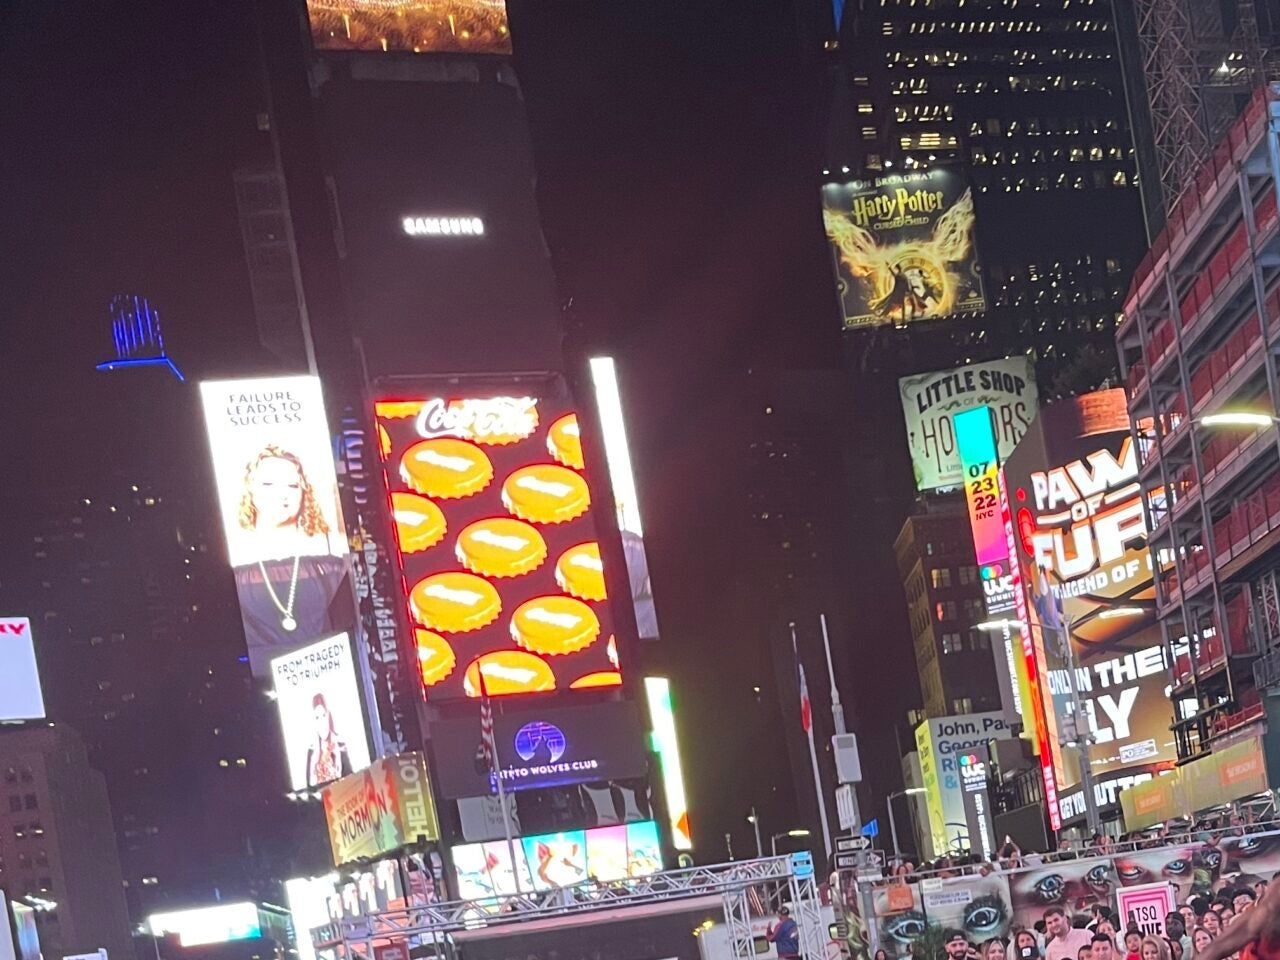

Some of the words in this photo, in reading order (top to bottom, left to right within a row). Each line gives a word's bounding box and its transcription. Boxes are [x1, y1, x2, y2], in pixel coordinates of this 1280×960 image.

[875, 172, 934, 187] BROADWAY
[852, 194, 897, 226] Harry
[896, 188, 944, 220] Potter
[402, 216, 484, 236] SAMSUNG
[229, 391, 295, 403] FAILURE
[916, 371, 976, 414] LITTLE
[979, 370, 1026, 396] SHOP
[227, 403, 277, 416] LEADS
[282, 401, 302, 412] TO
[230, 413, 302, 426] SUCCESS
[969, 461, 989, 478] 07
[971, 477, 994, 495] 23
[974, 493, 997, 511] 22
[1071, 493, 1105, 522] OF
[975, 510, 994, 521] NYC
[1111, 559, 1140, 584] OF
[277, 659, 303, 676] FROM
[304, 643, 345, 663] TRAGEDY
[286, 675, 299, 687] TO
[299, 660, 341, 682] TRIUMPH
[937, 722, 980, 738] John,
[530, 763, 571, 776] WOLVES
[572, 759, 598, 770] CLUB
[399, 758, 430, 839] HELLO!
[338, 788, 388, 849] MORMON
[1135, 905, 1157, 922] TSQ
